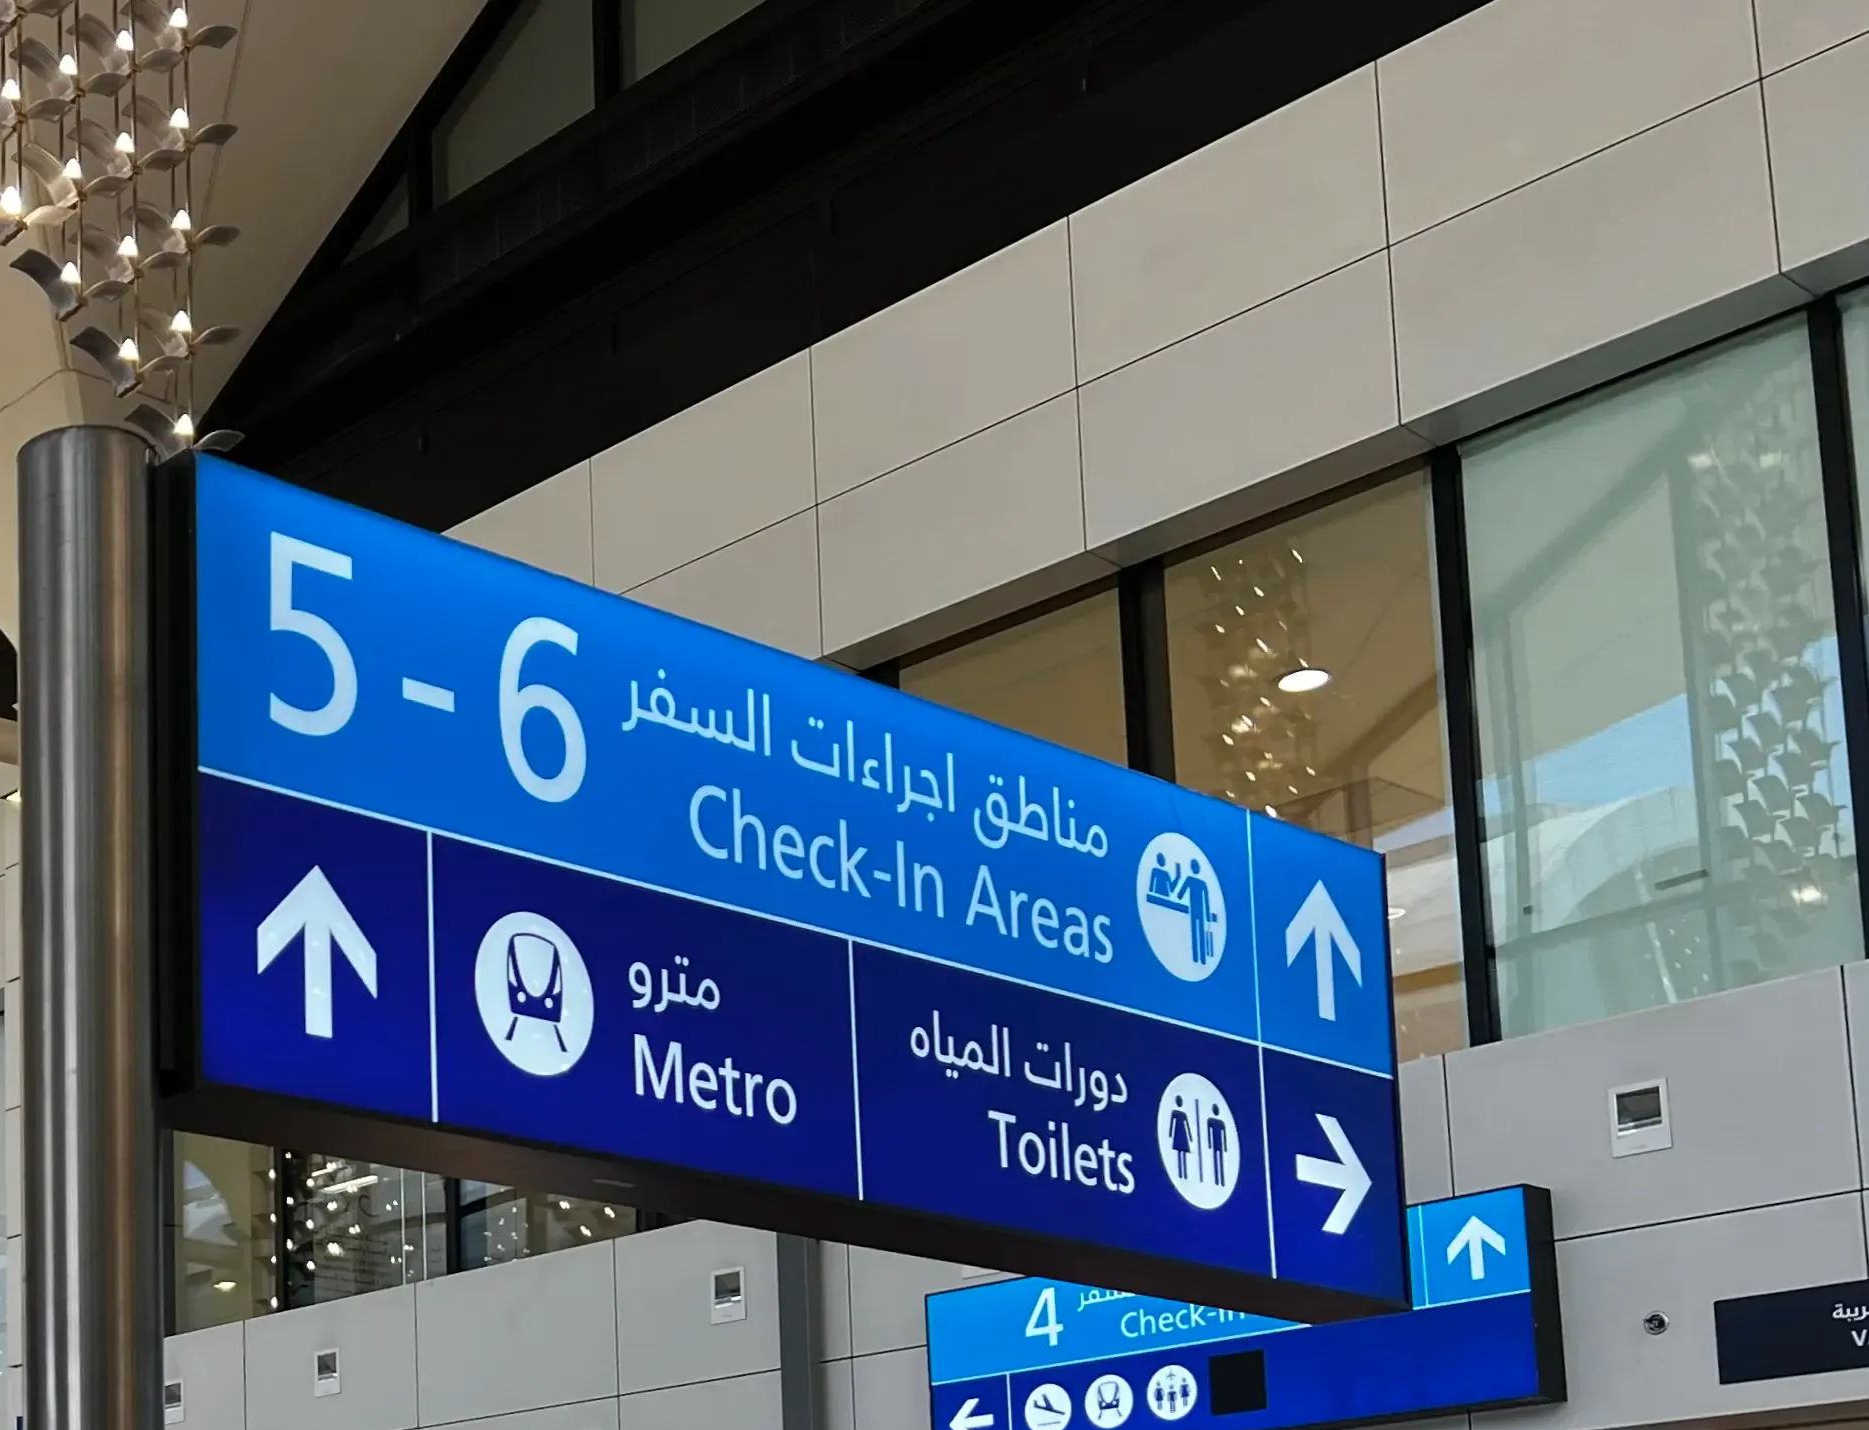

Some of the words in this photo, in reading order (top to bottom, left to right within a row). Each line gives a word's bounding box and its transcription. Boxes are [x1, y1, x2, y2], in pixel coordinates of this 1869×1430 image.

[269, 530, 358, 736] 5
[499, 616, 588, 802] 6
[621, 668, 772, 757] السفر
[974, 774, 1109, 858] مناطق
[688, 784, 945, 918] Check-In
[965, 864, 1114, 964] Areas
[628, 955, 721, 1012] مترو
[632, 1032, 799, 1126] Metro
[909, 1009, 1011, 1083] المياه
[1023, 1042, 1129, 1113] دورات
[987, 1110, 1136, 1196] Toilets
[1024, 1286, 1064, 1346] 4
